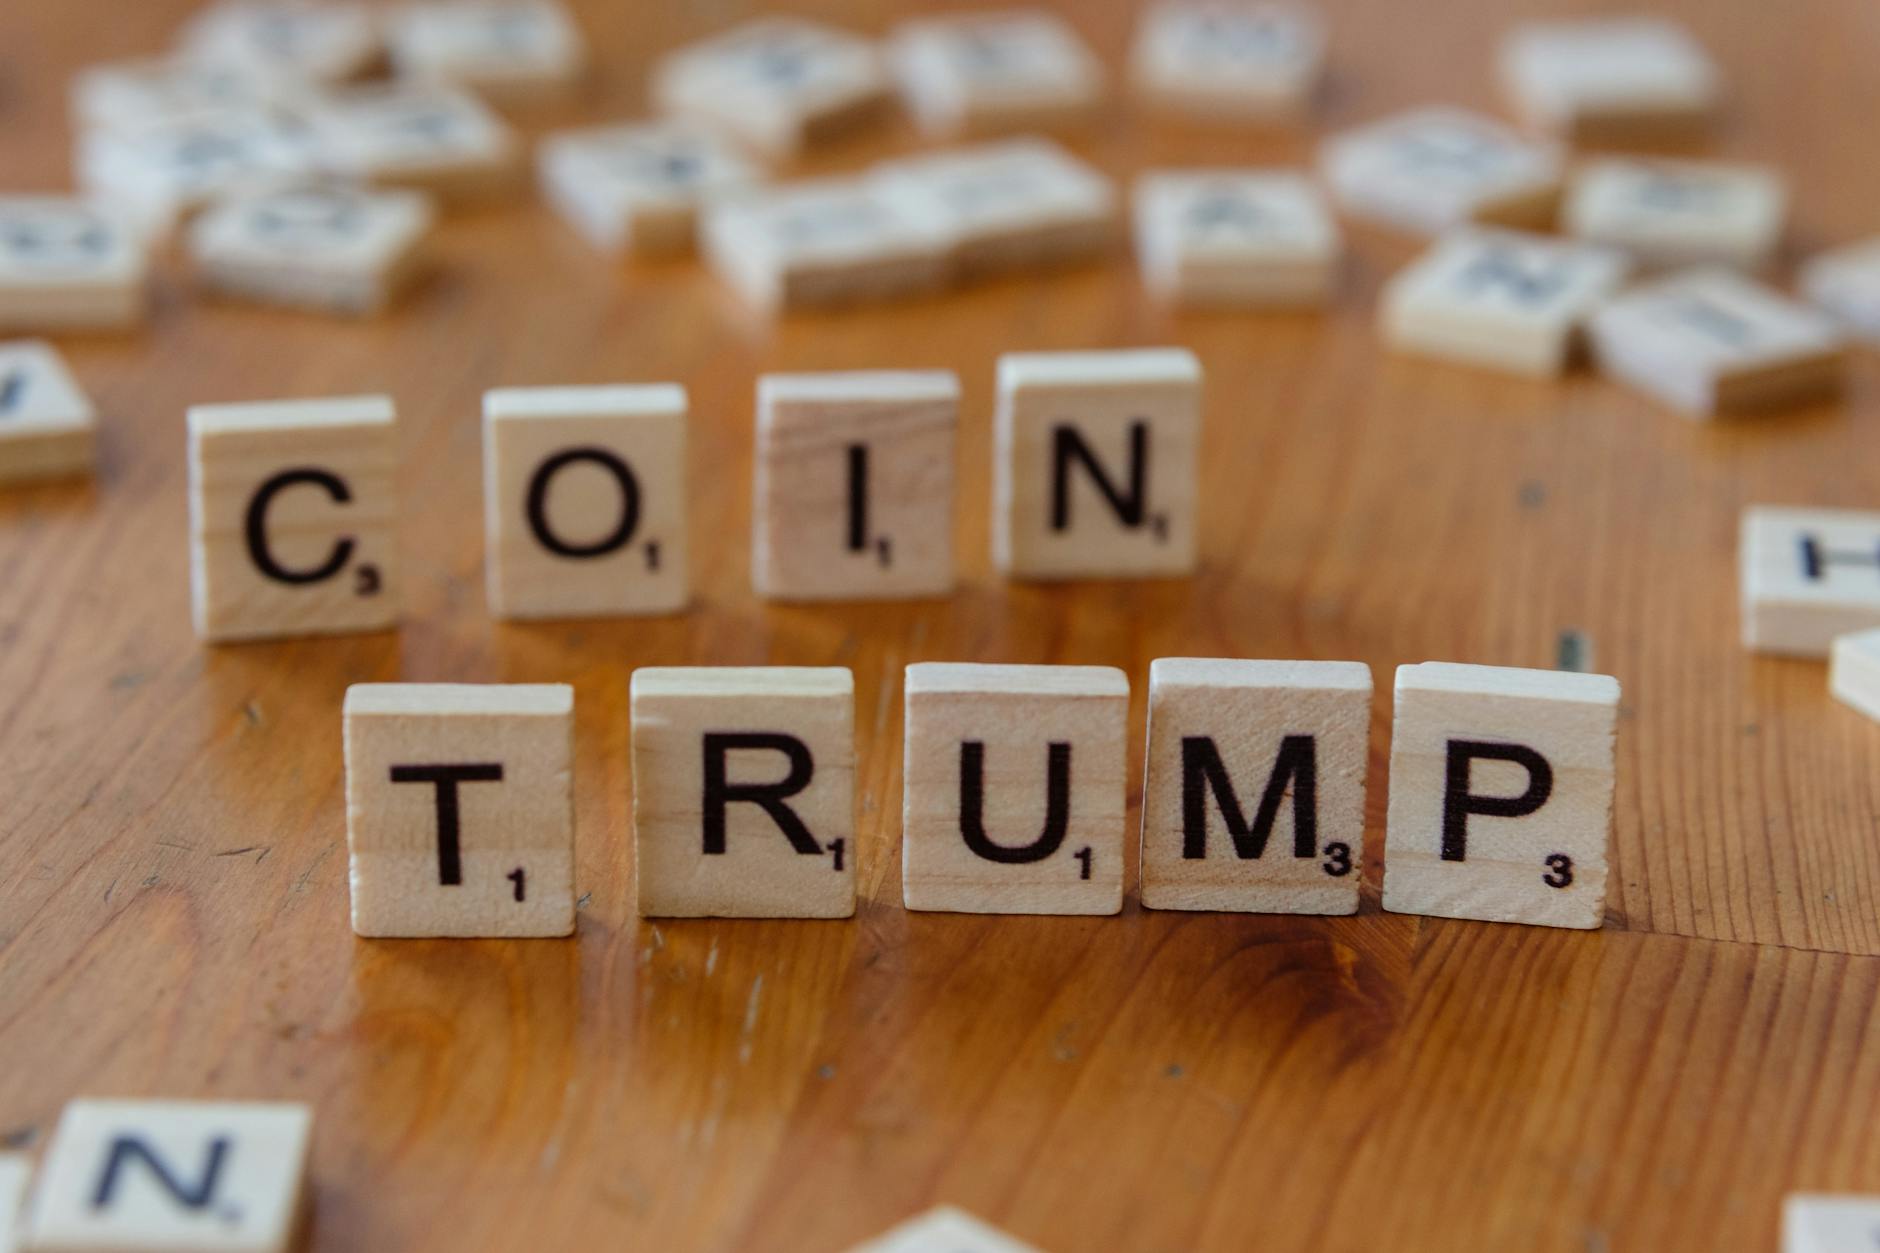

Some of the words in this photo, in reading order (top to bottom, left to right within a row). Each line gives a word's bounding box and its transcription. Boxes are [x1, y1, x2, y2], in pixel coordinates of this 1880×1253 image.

[240, 464, 358, 590] C
[522, 445, 645, 563] O
[642, 540, 662, 572] 1
[1049, 418, 1152, 532] N
[388, 761, 505, 887] T
[505, 866, 527, 903] 1
[699, 730, 826, 857] R
[825, 836, 847, 873] 1
[957, 739, 1074, 866] U
[1073, 845, 1094, 881] 1
[1180, 734, 1318, 862] M
[1321, 841, 1353, 878] 3
[1439, 738, 1555, 863] P
[1542, 853, 1575, 890] 3
[90, 1133, 232, 1214] N
